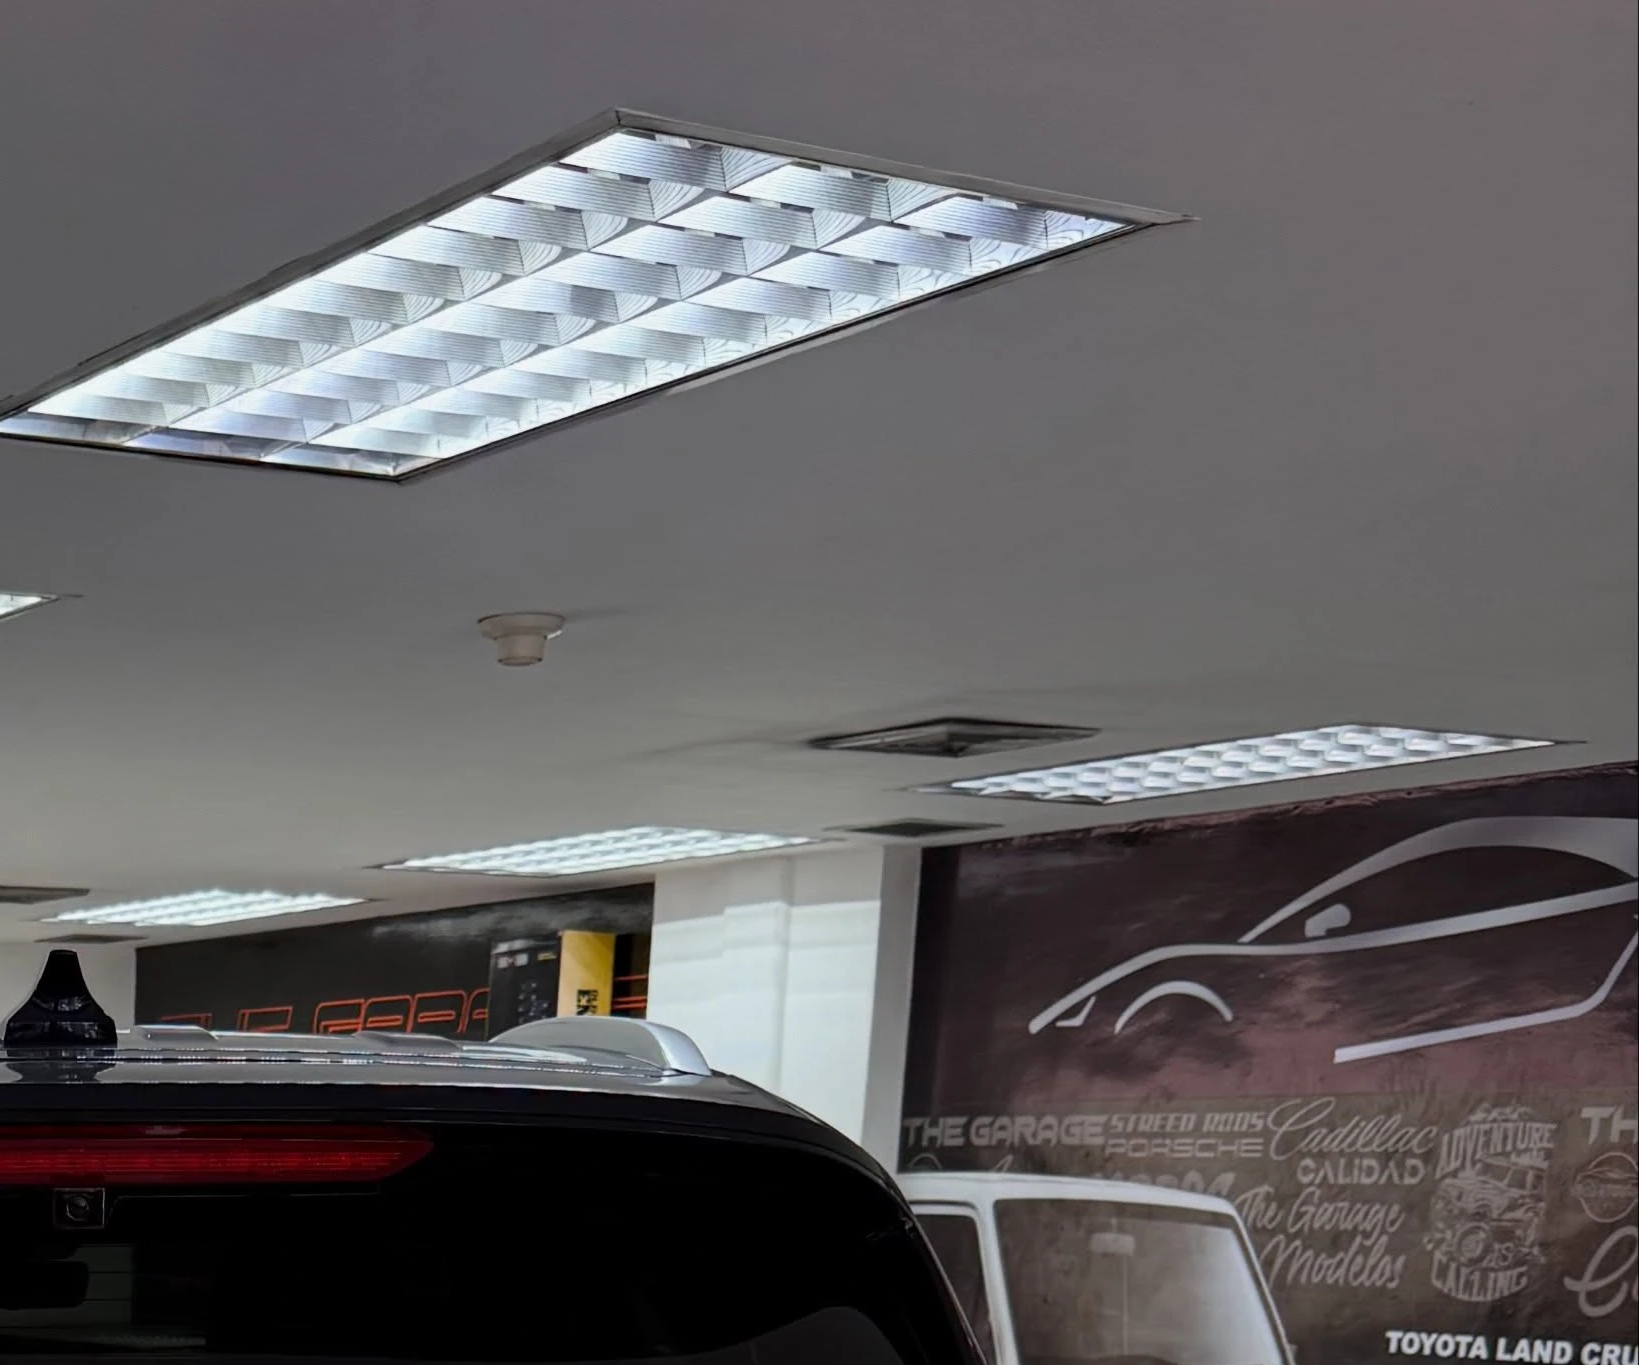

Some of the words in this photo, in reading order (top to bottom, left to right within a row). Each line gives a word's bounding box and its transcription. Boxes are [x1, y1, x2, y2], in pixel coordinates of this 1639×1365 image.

[903, 1116, 968, 1147] THE
[969, 1114, 1109, 1147] GARAGE
[1106, 1138, 1265, 1158] PORSCHE
[1266, 1097, 1437, 1161] Cadillac
[1434, 1121, 1558, 1180] ADVENTURE
[1296, 1158, 1427, 1186] CALIDAD
[1235, 1184, 1283, 1231] The
[1287, 1186, 1406, 1246] Garage
[1261, 1234, 1407, 1290] Modelos
[1385, 1330, 1489, 1361] TOYOTA
[1495, 1337, 1573, 1365] LAND
